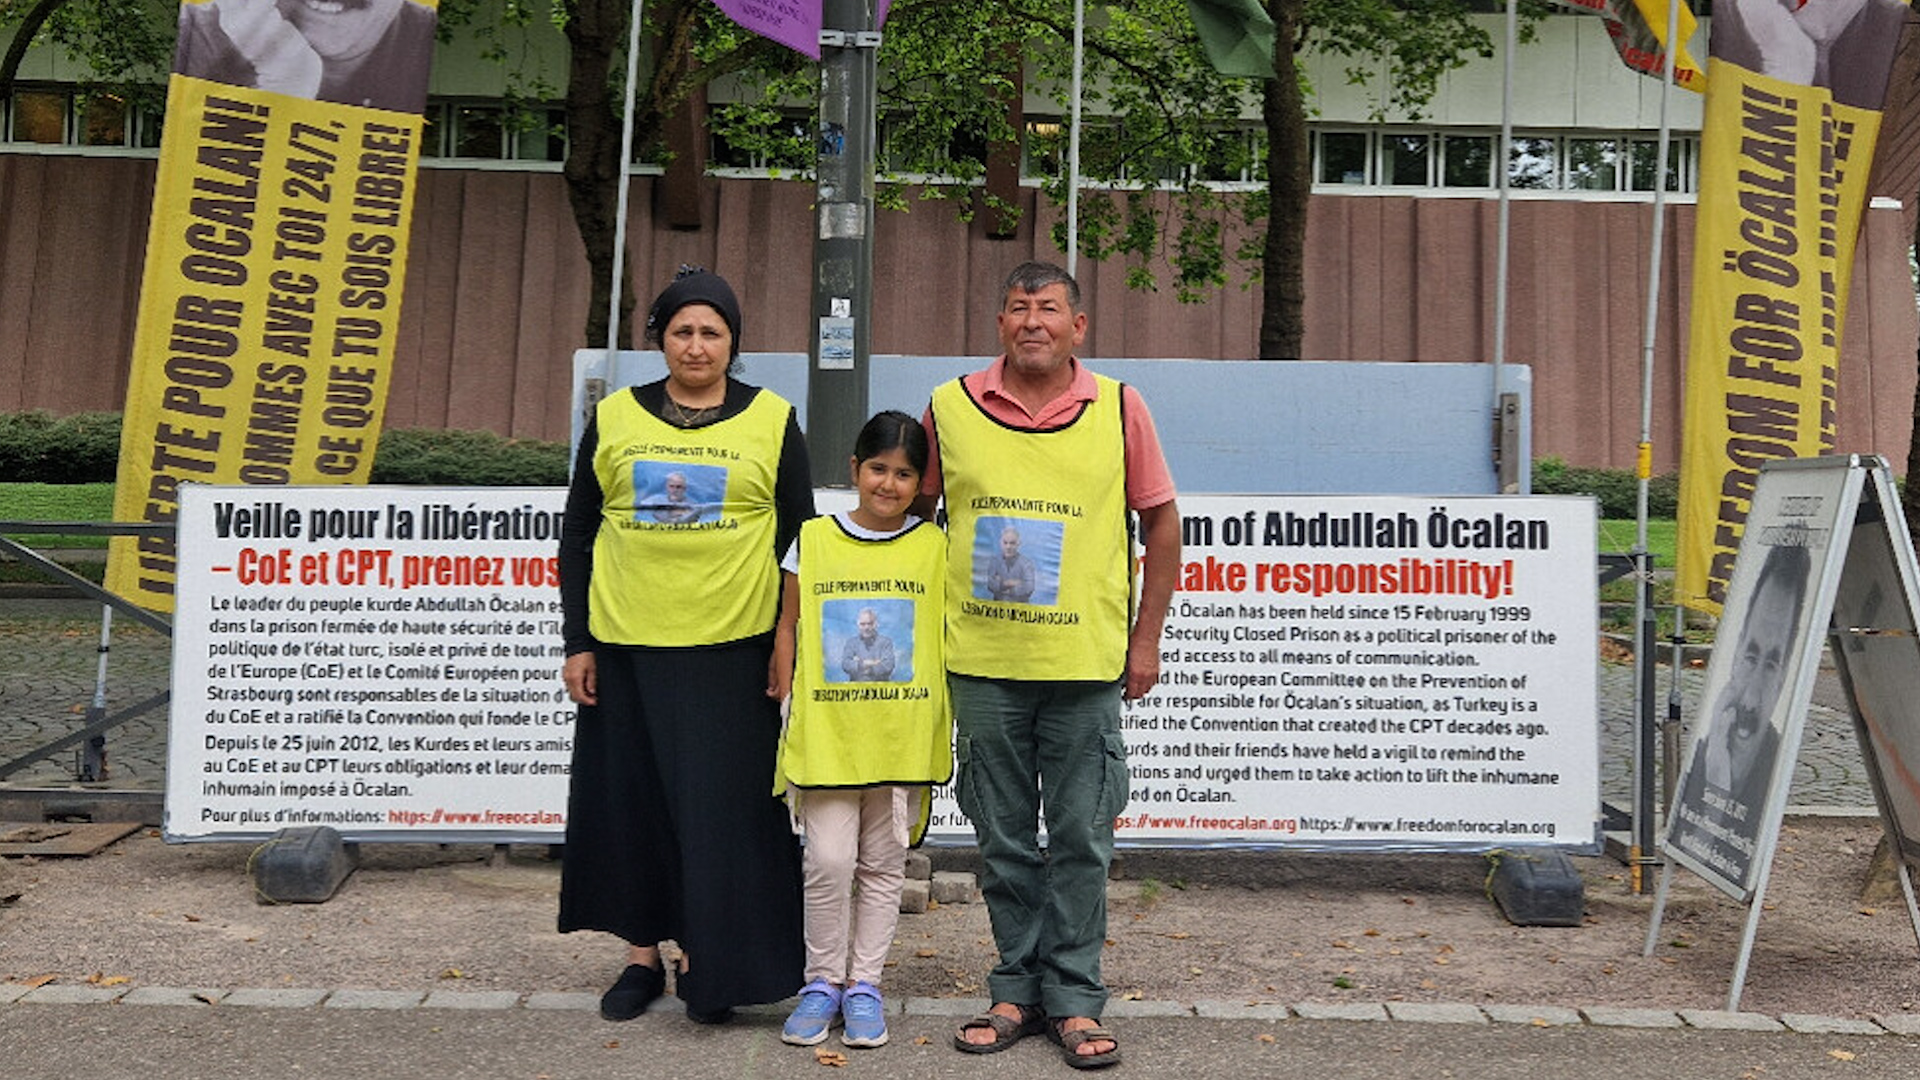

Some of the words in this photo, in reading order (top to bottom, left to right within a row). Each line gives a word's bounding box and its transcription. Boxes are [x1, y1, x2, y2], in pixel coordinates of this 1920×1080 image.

[284, 118, 346, 203] 24/7,
[351, 122, 411, 228] LIBRE!
[1723, 83, 1801, 288] ÖCALAN!
[179, 96, 270, 288] OCALAN!
[274, 206, 327, 262] TOI
[339, 231, 396, 310] SOIS
[263, 269, 319, 358] AVEC
[332, 317, 384, 357] TU
[1728, 293, 1802, 388] FOR
[162, 294, 244, 418] POUR
[322, 364, 376, 428] QUE
[239, 362, 307, 485] OMMES
[314, 435, 363, 476] CE
[214, 502, 301, 538] Veille
[308, 509, 380, 542] pour
[386, 504, 414, 540] la
[421, 503, 565, 541] libération
[1222, 510, 1256, 546] of
[1263, 511, 1418, 548] Abdullah
[1428, 507, 1548, 550] Öcalan
[237, 548, 292, 586] CoE
[300, 552, 330, 586] et
[336, 549, 394, 588] CPT,
[402, 556, 505, 589] prenez
[511, 557, 561, 588] vos
[1256, 558, 1513, 599] responsibility!
[234, 596, 283, 611] leader
[286, 596, 305, 611] du
[310, 597, 363, 615] peuple
[367, 597, 412, 612] kurde
[414, 597, 486, 612] Abdullah
[489, 594, 544, 613] Öcalan
[1180, 599, 1235, 618] Öcalan
[1239, 604, 1265, 619] has
[1269, 604, 1306, 619] been
[1310, 605, 1344, 619] held
[1348, 604, 1390, 620] since
[1393, 605, 1411, 620] 15
[1415, 605, 1486, 625] February
[1489, 606, 1531, 621] 1999
[209, 618, 247, 633] dans
[268, 618, 317, 637] prison
[321, 618, 376, 634] fermée
[402, 620, 446, 635] haute
[450, 620, 513, 635] sécurité
[1164, 625, 1229, 645] Security
[1234, 626, 1286, 641] Closed
[1290, 626, 1340, 642] Prison
[1378, 628, 1442, 646] political
[1444, 629, 1509, 646] prisoner
[1531, 630, 1557, 645] the
[209, 640, 278, 659] politique
[349, 643, 384, 658] turc,
[388, 642, 426, 657] isolé
[448, 642, 488, 660] privé
[514, 644, 545, 658] tout
[1184, 652, 1236, 663] access
[1259, 649, 1278, 664] all
[1282, 652, 1332, 664] means
[1355, 650, 1480, 666] communication.
[301, 663, 344, 680] (CoE)
[385, 664, 440, 680] Comité
[444, 664, 519, 684] Européen
[522, 669, 558, 683] pour
[1174, 670, 1199, 685] the
[1202, 670, 1277, 690] European
[1281, 672, 1366, 687] Committee
[1392, 673, 1417, 688] the
[1421, 673, 1507, 689] Prevention
[1511, 675, 1527, 689] of
[207, 685, 293, 706] Strasbourg
[297, 688, 330, 702] sont
[334, 687, 438, 705] responsables
[482, 687, 550, 703] situation
[1137, 696, 1161, 709] are
[1166, 693, 1255, 712] responsible
[1259, 694, 1280, 709] for
[1356, 696, 1428, 713] situation,
[1432, 699, 1450, 712] as
[1453, 696, 1508, 716] Turkey
[229, 709, 261, 724] CoE
[297, 709, 344, 724] ratifié
[366, 709, 455, 725] Convention
[459, 710, 483, 729] qui
[487, 711, 531, 726] fonde
[1162, 715, 1187, 731] the
[1190, 715, 1279, 731] Convention
[1283, 717, 1314, 732] that
[1318, 718, 1377, 734] created
[1381, 719, 1406, 734] the
[1409, 719, 1444, 733] CPT
[1447, 719, 1512, 735] decades
[1516, 723, 1549, 739] ago.
[205, 734, 259, 753] Depuis
[281, 735, 303, 751] 25
[306, 735, 335, 754] juin
[340, 735, 383, 753] 2012,
[388, 736, 410, 751] les
[414, 736, 469, 751] Kurdes
[492, 737, 532, 751] leurs
[535, 738, 571, 752] amis
[1162, 742, 1191, 757] and
[1194, 742, 1231, 757] their
[1235, 742, 1289, 758] friends
[1292, 743, 1330, 759] have
[1334, 744, 1368, 759] held
[1384, 744, 1418, 763] vigil
[1441, 746, 1496, 761] remind
[1500, 746, 1526, 761] the
[227, 758, 259, 773] CoE
[305, 758, 340, 773] CPT
[342, 758, 382, 774] leurs
[385, 758, 472, 778] obligations
[495, 759, 526, 775] leur
[1174, 764, 1202, 780] and
[1206, 766, 1251, 785] urged
[1255, 766, 1294, 781] them
[1316, 767, 1351, 782] take
[1354, 767, 1403, 782] action
[1426, 768, 1448, 783] lift
[1452, 768, 1478, 783] the
[1482, 768, 1559, 785] inhumane
[203, 780, 276, 796] inhumain
[280, 781, 336, 800] imposé
[353, 778, 413, 797] Öcalan.
[1176, 784, 1236, 802] Öcalan.
[201, 808, 237, 822] Pour
[240, 809, 271, 826] plus
[388, 809, 565, 827] https://www.freeocalan.
